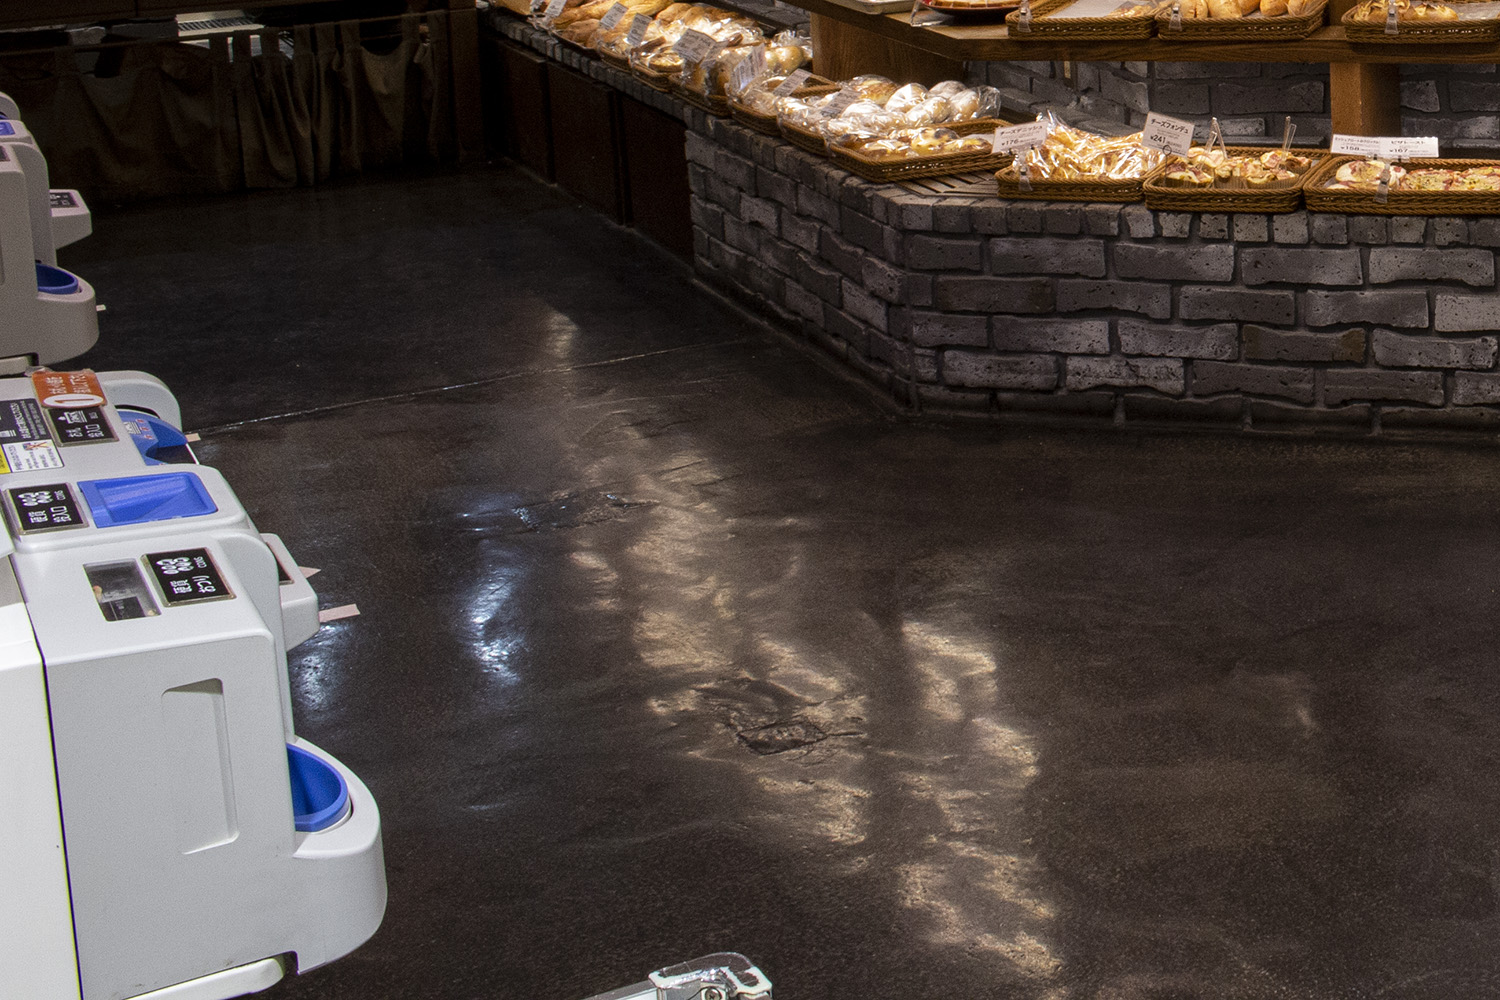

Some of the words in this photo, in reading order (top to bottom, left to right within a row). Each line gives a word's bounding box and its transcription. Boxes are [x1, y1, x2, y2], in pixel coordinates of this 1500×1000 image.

[1151, 118, 1189, 134] チーズフォンデュ
[1150, 134, 1166, 144] ¥241
[28, 510, 48, 524] 硬貨
[51, 505, 71, 523] 投入口
[195, 556, 207, 569] COINS
[170, 579, 192, 594] 硬貨
[192, 575, 216, 593] おつり
